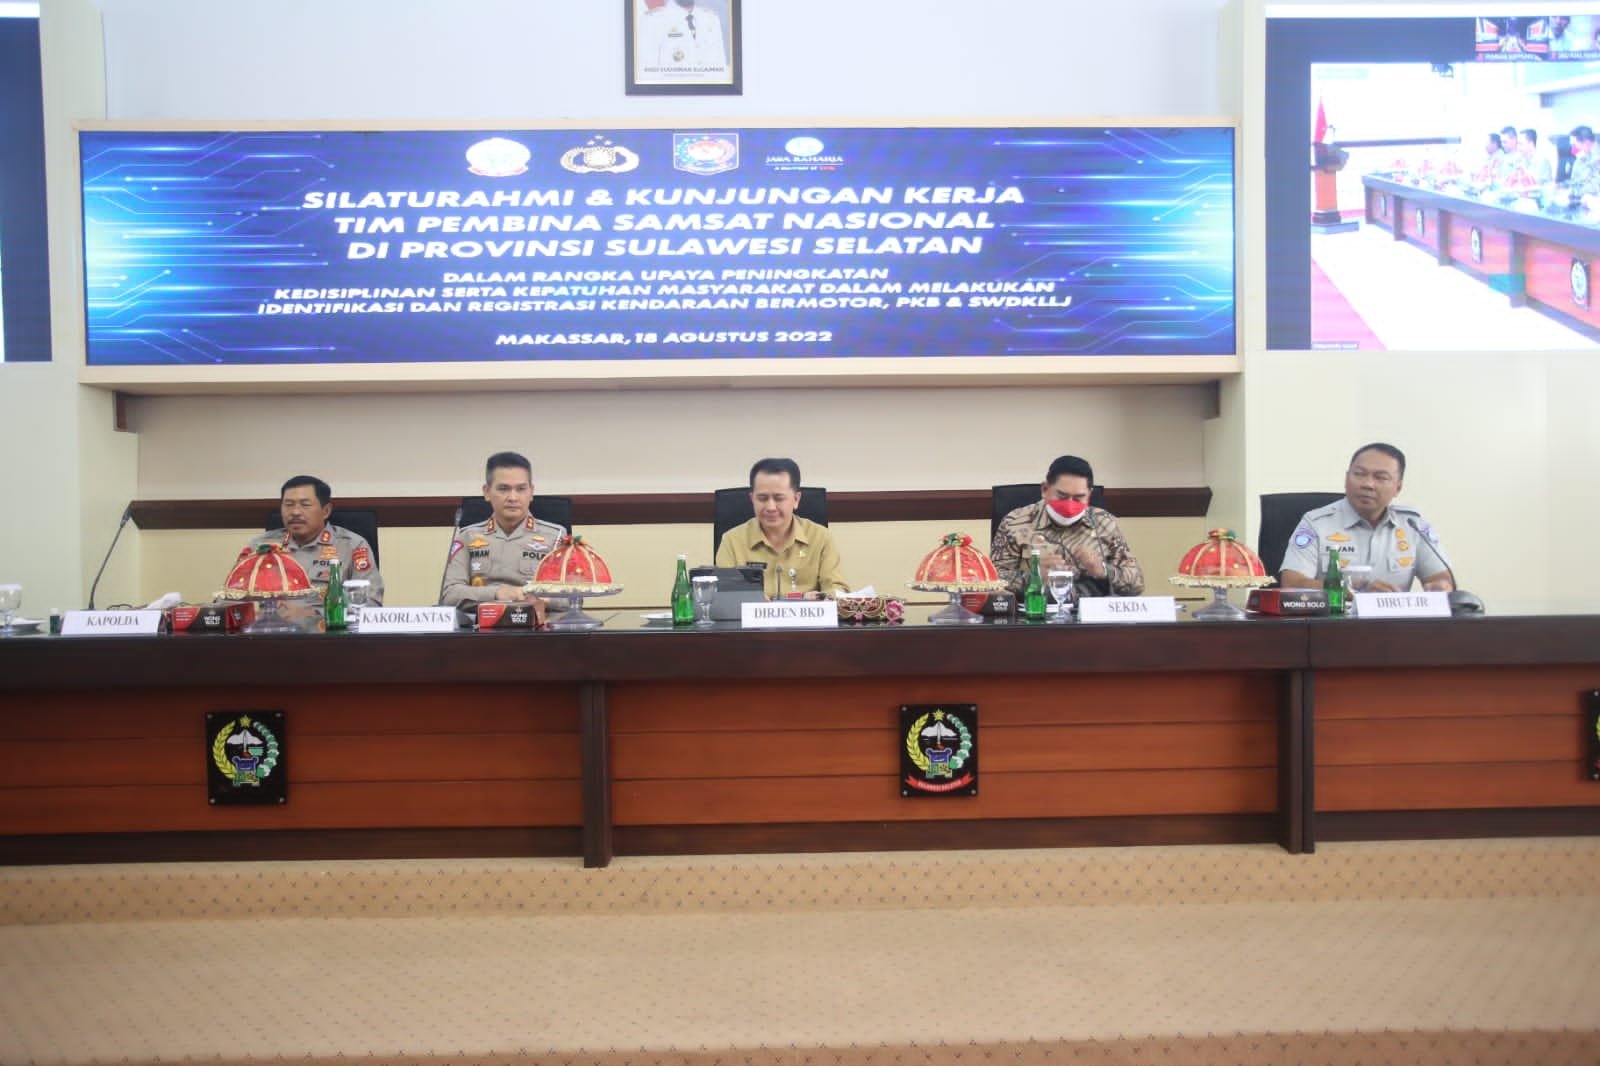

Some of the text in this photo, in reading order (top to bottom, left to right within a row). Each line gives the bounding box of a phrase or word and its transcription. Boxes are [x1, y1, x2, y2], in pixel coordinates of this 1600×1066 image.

[302, 187, 1024, 209] SILATURAHMI & KUNJUNGAN KERJA
[334, 212, 994, 234] TIM PEMBINA SAMSAT NASIONAL
[348, 237, 982, 259] DI PROVINSI SULAWESI SELATAN
[443, 268, 889, 283] DALAM RANGKA UPAYA PENINGKATAN
[275, 282, 1055, 299] KEDISIPLINAN SERTA KEPATUHAN MASYARAKAT DALAM MELAKUKAN
[258, 296, 1071, 314] IDENTIFIKASI DAN REGISTRASI KENDARAAN BERMOTOR, PKB & SWDKLLJ
[495, 331, 833, 345] MAKASSAR, 18 AGUSTUS 2022
[753, 606, 826, 618] DIRJEN BKD
[1107, 600, 1149, 613] SEKDA
[1282, 601, 1326, 609] WONG SOLO
[86, 615, 140, 626] KAPOLDA
[362, 611, 452, 625] KAKORLANTAS
